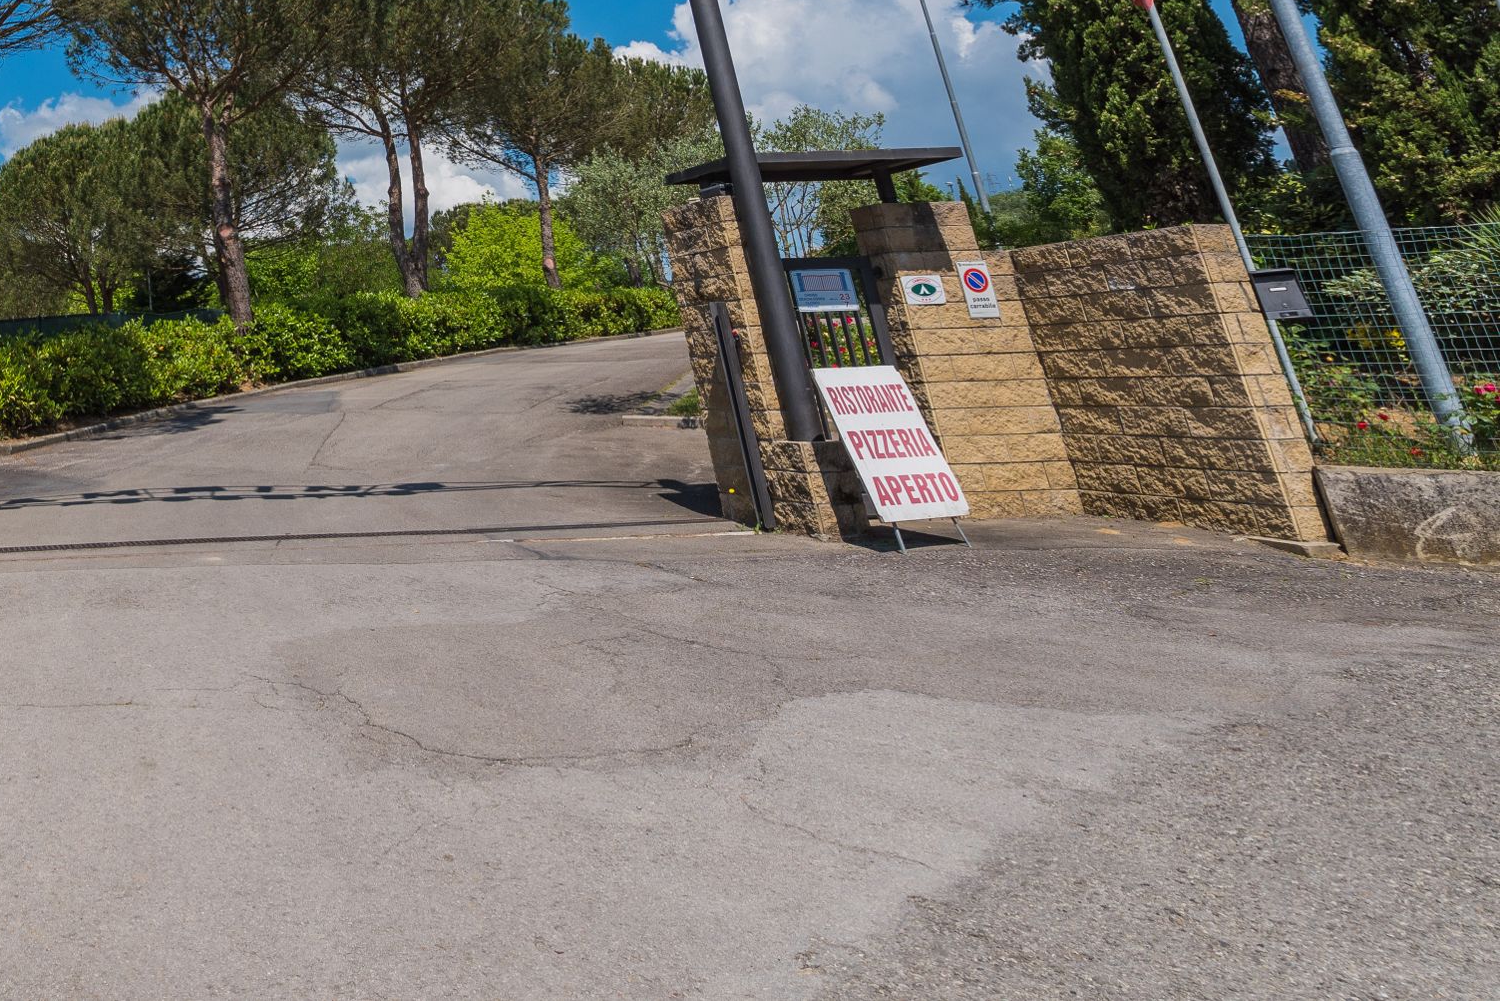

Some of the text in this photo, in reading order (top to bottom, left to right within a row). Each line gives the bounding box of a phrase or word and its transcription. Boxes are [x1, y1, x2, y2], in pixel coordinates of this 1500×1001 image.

[826, 384, 913, 415] RISTORANTE
[847, 428, 937, 460] PIZZERIA
[872, 471, 960, 507] APERTO
